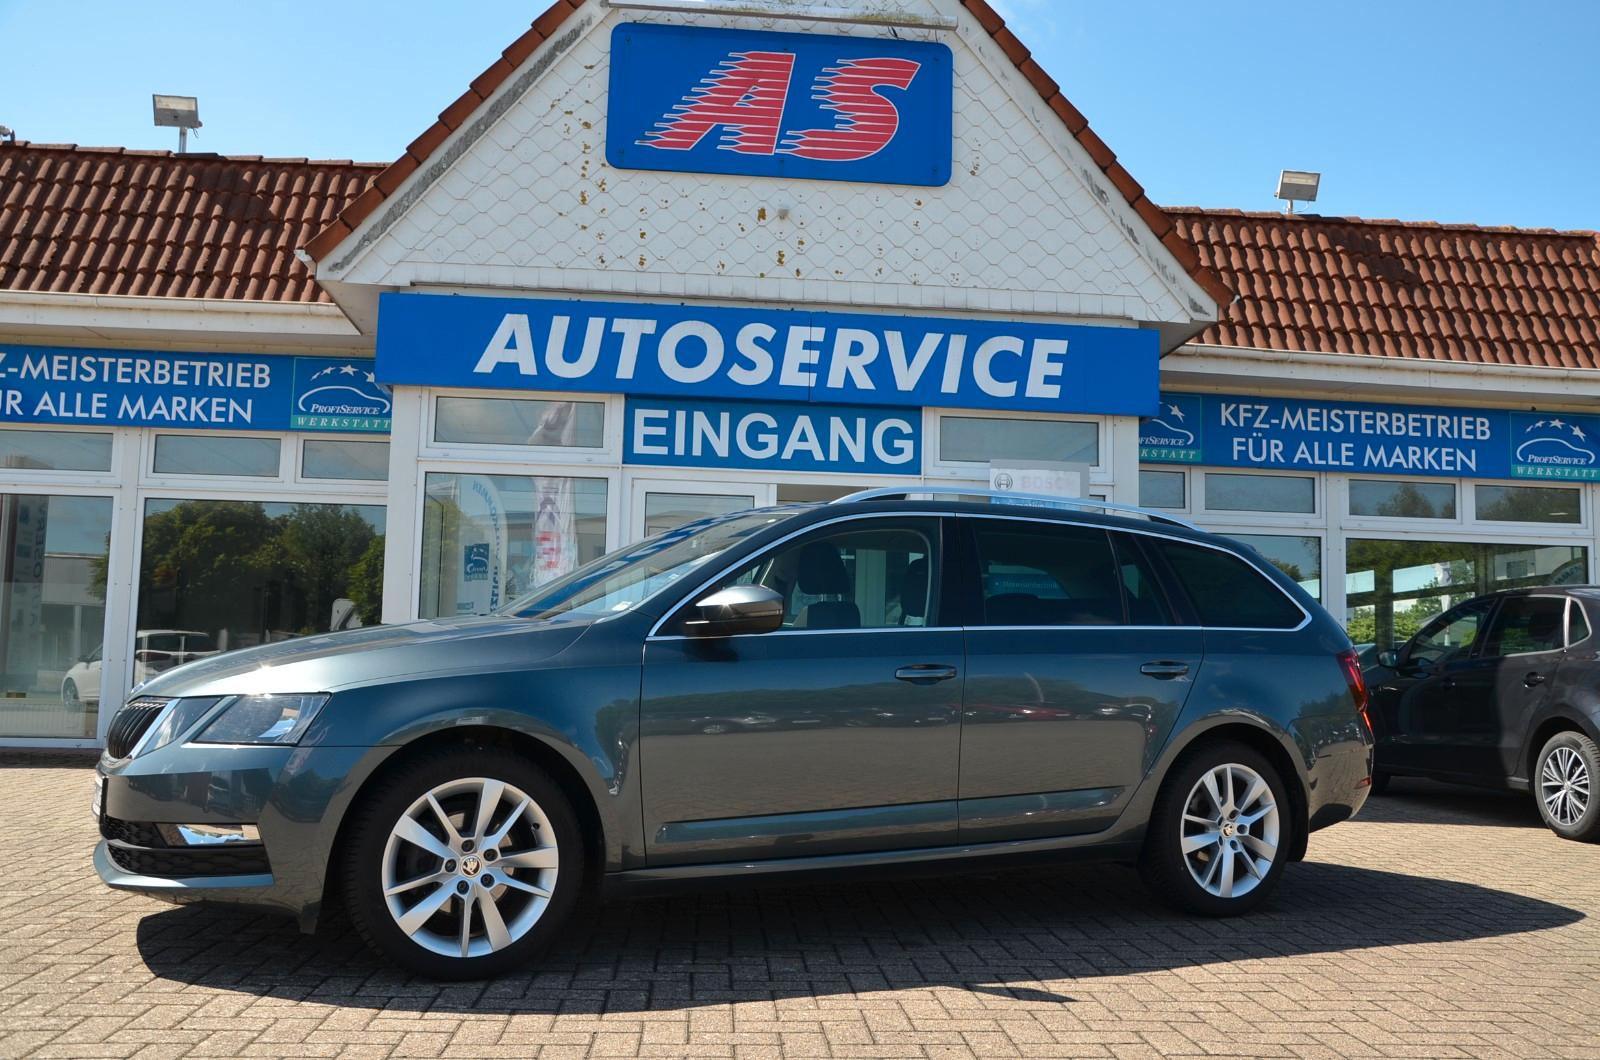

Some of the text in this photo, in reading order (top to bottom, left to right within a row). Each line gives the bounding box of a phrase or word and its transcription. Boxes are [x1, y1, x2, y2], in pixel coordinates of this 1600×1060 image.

[634, 51, 922, 162] AS
[472, 312, 1069, 399] AUTOSERVICE
[33, 391, 108, 420] ALLE
[117, 394, 253, 424] MARKEN
[297, 416, 391, 429] WERKSTATT
[1220, 402, 1492, 441] KFZ-MEISTERBETRIEB
[633, 408, 915, 465] EINGANG
[1232, 433, 1476, 473] FÜR ALLE MARKEN
[1516, 466, 1598, 478] WERKSTATT
